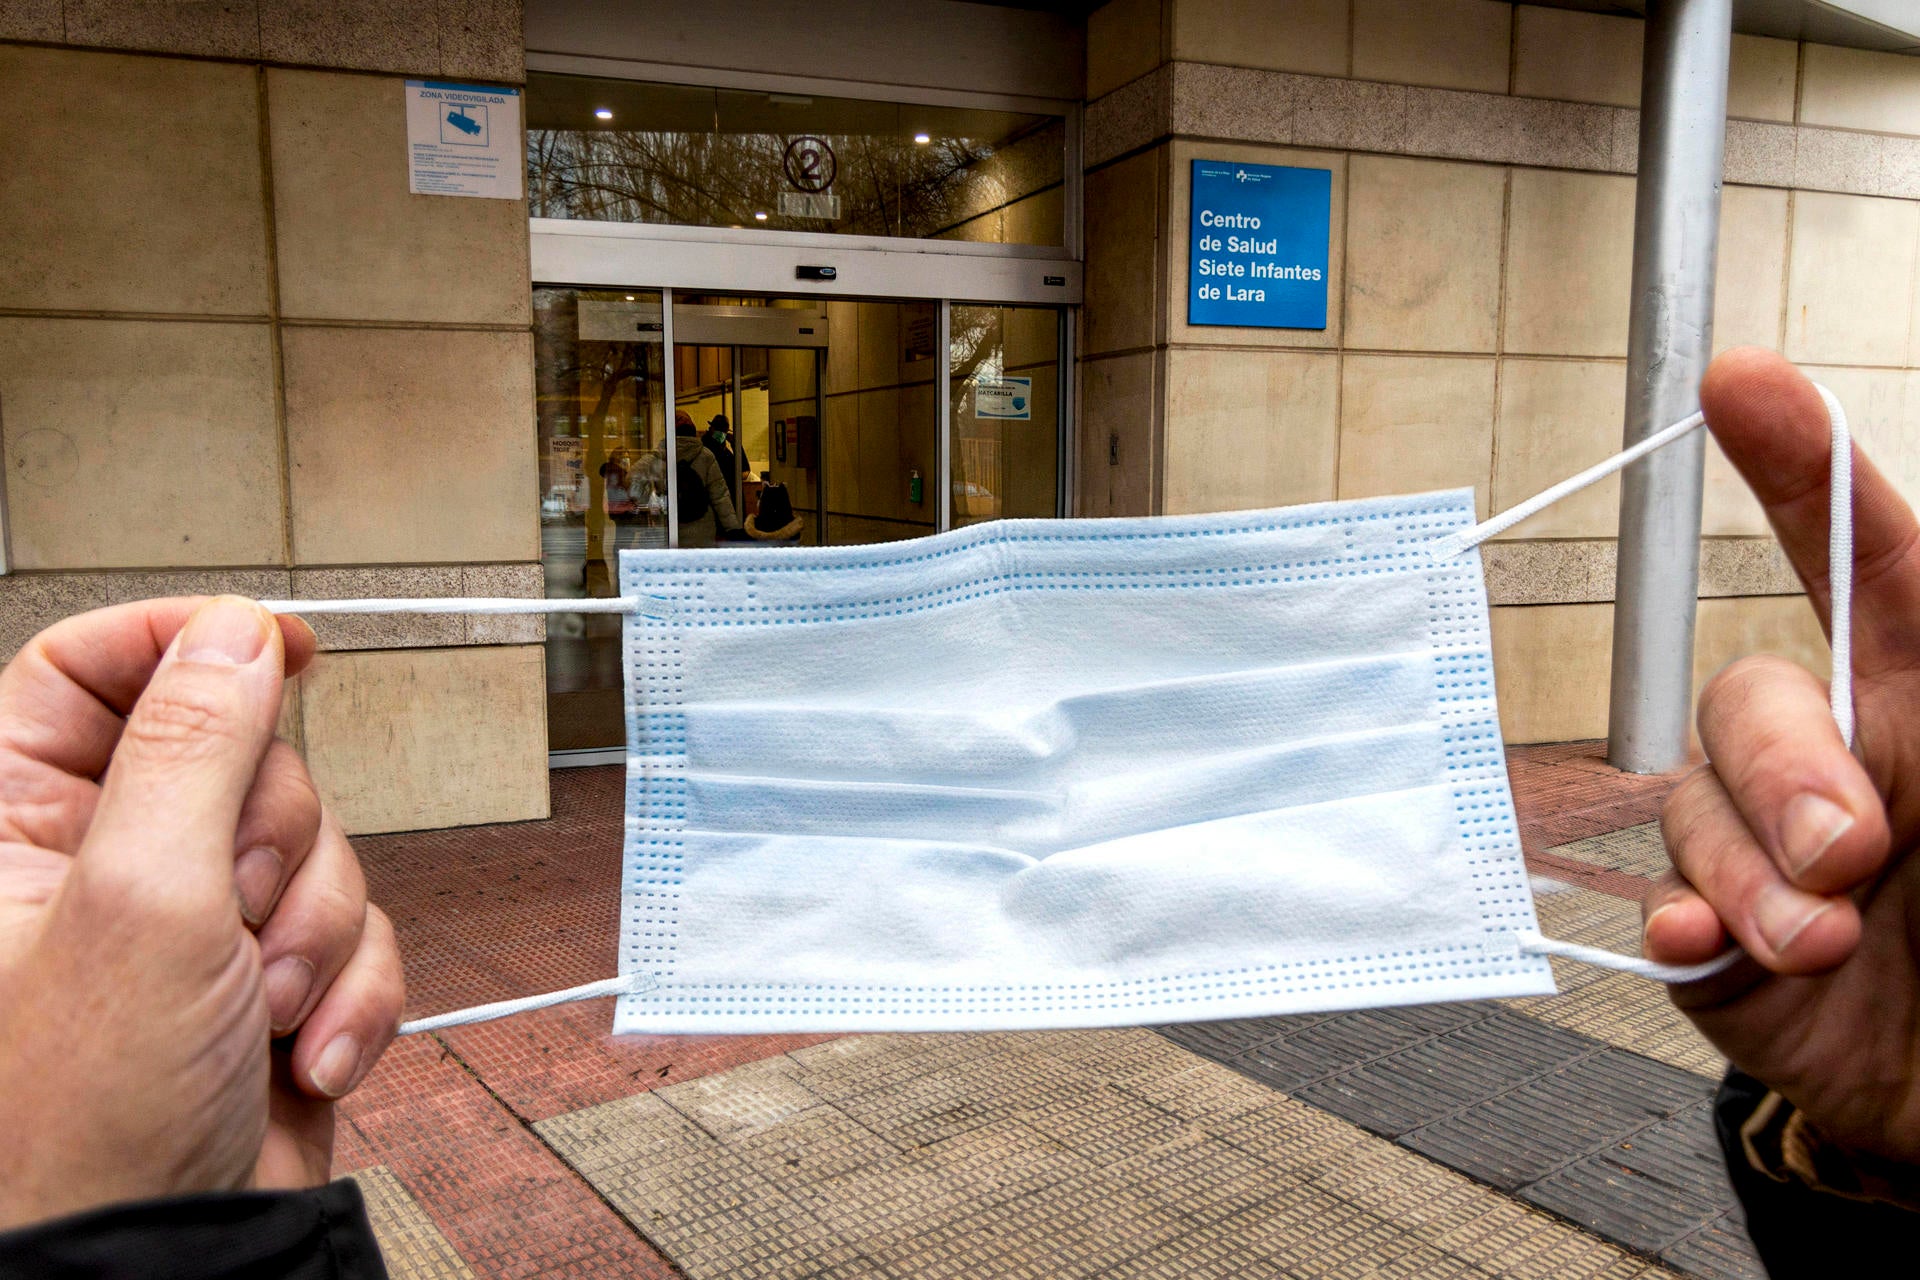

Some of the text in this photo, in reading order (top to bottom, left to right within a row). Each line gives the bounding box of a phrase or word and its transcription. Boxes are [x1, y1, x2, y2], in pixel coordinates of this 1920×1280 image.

[420, 91, 506, 104] ZONA VIDEOVIGILADA
[800, 149, 821, 179] 2
[1200, 210, 1261, 230] Centro
[1199, 235, 1277, 255] de Salud
[1199, 259, 1322, 281] Siete Infantes
[1198, 283, 1266, 302] de Lara
